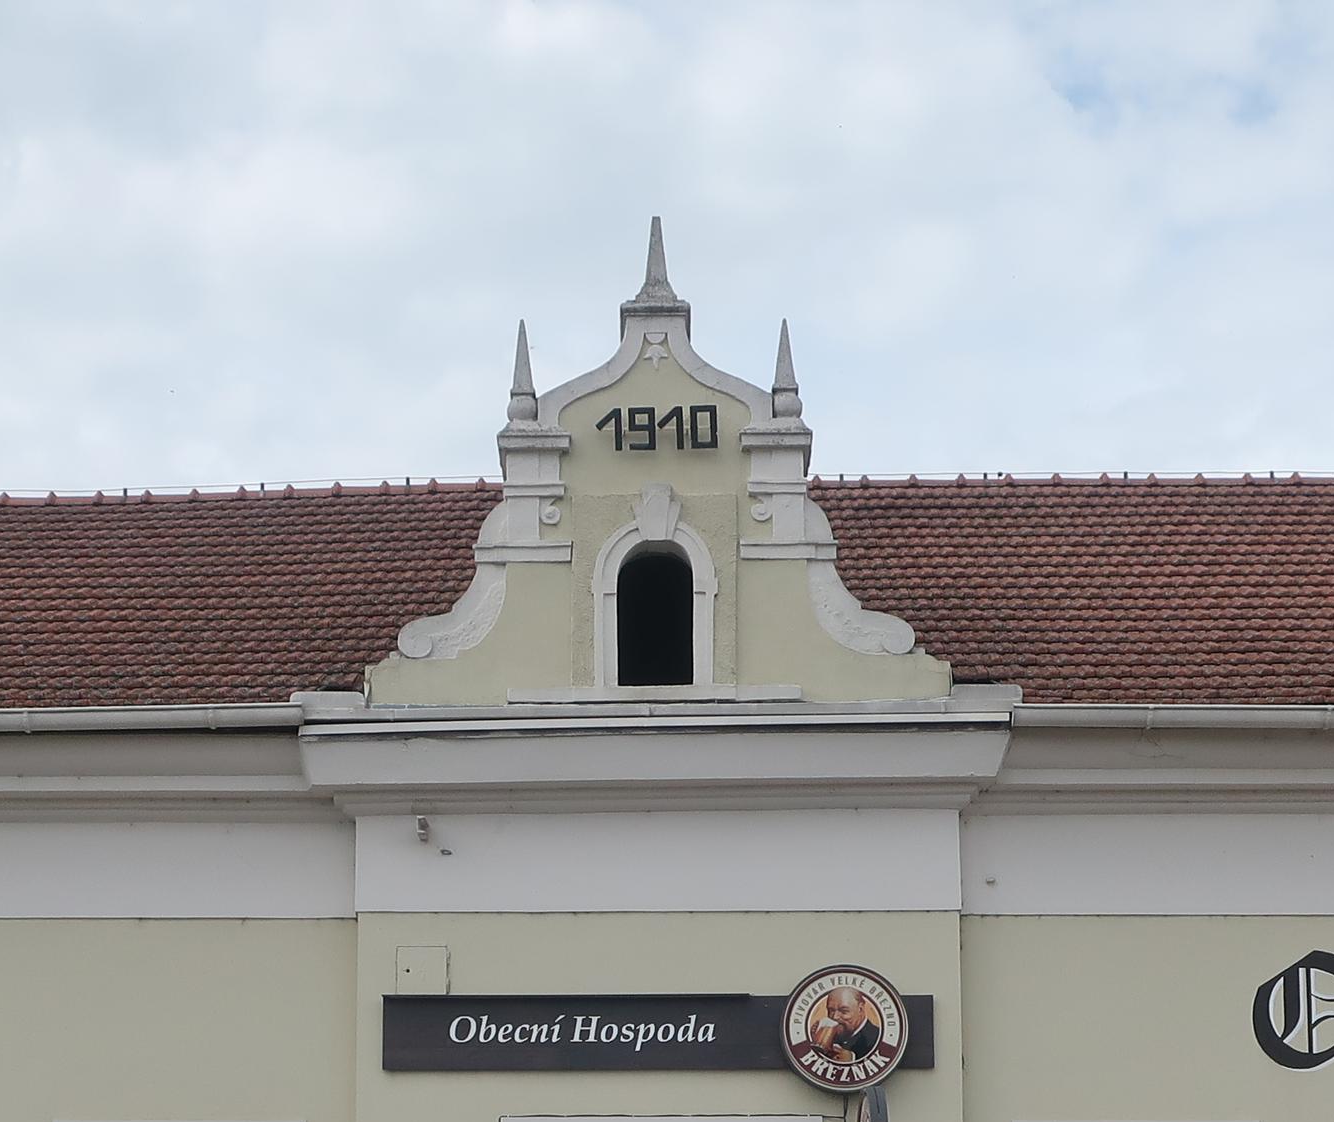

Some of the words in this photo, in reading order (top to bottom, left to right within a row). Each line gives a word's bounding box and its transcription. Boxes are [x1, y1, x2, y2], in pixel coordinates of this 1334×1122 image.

[595, 405, 718, 451] 1910
[793, 982, 827, 1025] PIVOVAR
[829, 976, 866, 989] VELKÉ
[449, 1014, 565, 1043] Obecní
[570, 1015, 716, 1051] Hospoda
